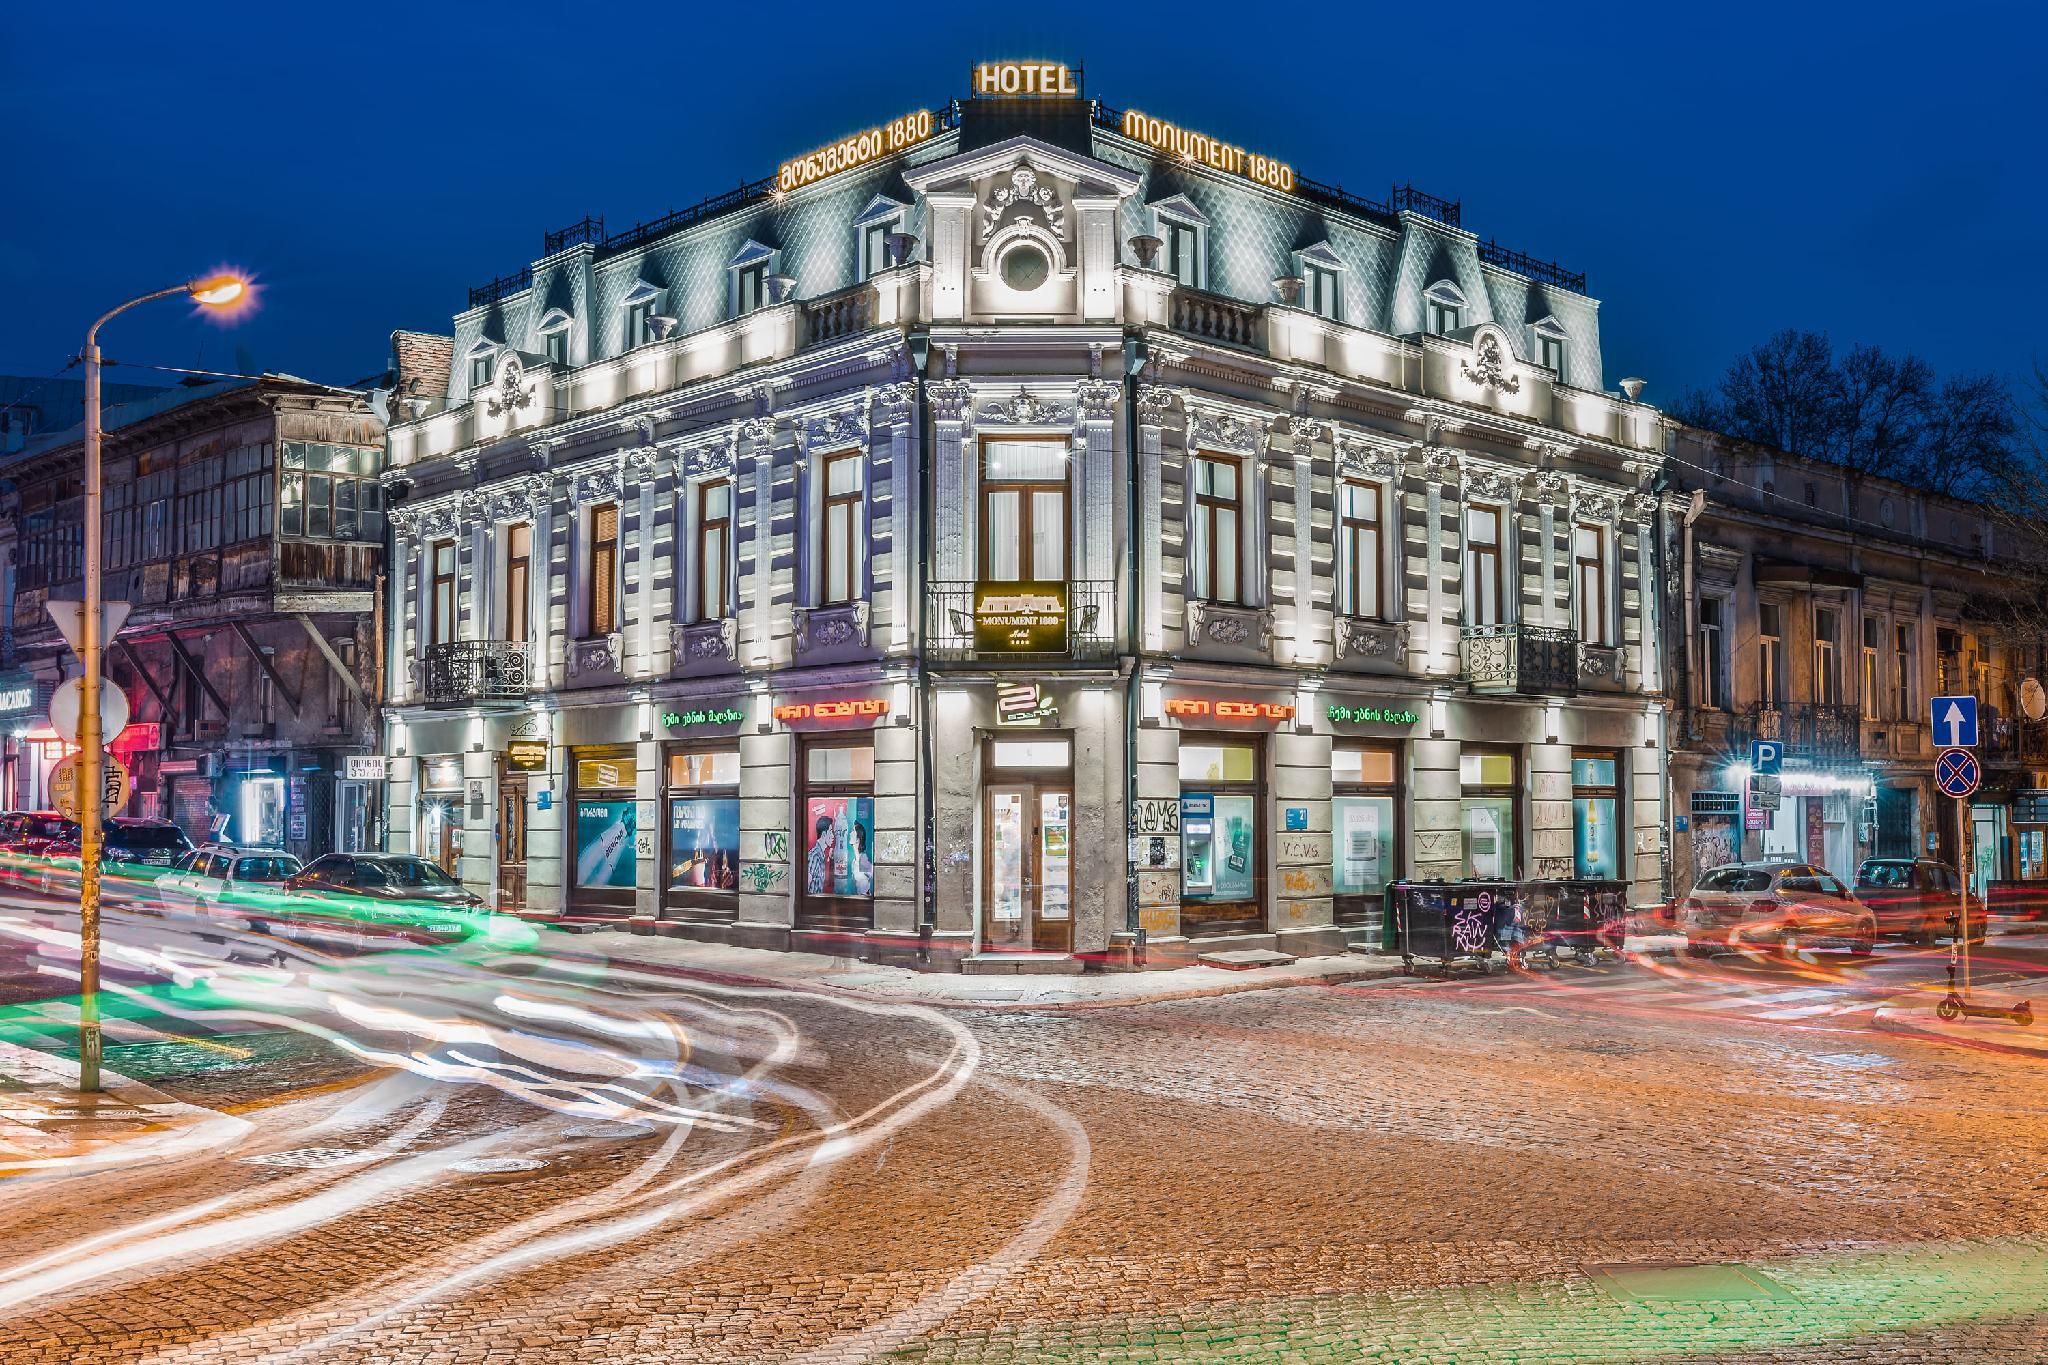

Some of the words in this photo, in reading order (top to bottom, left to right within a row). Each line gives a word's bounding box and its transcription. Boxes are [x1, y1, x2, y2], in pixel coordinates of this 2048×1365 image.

[979, 63, 1077, 95] HOTEL
[780, 129, 883, 191] მონუმენტი
[886, 110, 931, 150] 1880
[1124, 110, 1245, 174] MONUMENT
[1247, 153, 1293, 192] 1880
[982, 616, 1038, 626] MONUMENT
[1758, 744, 1776, 770] P
